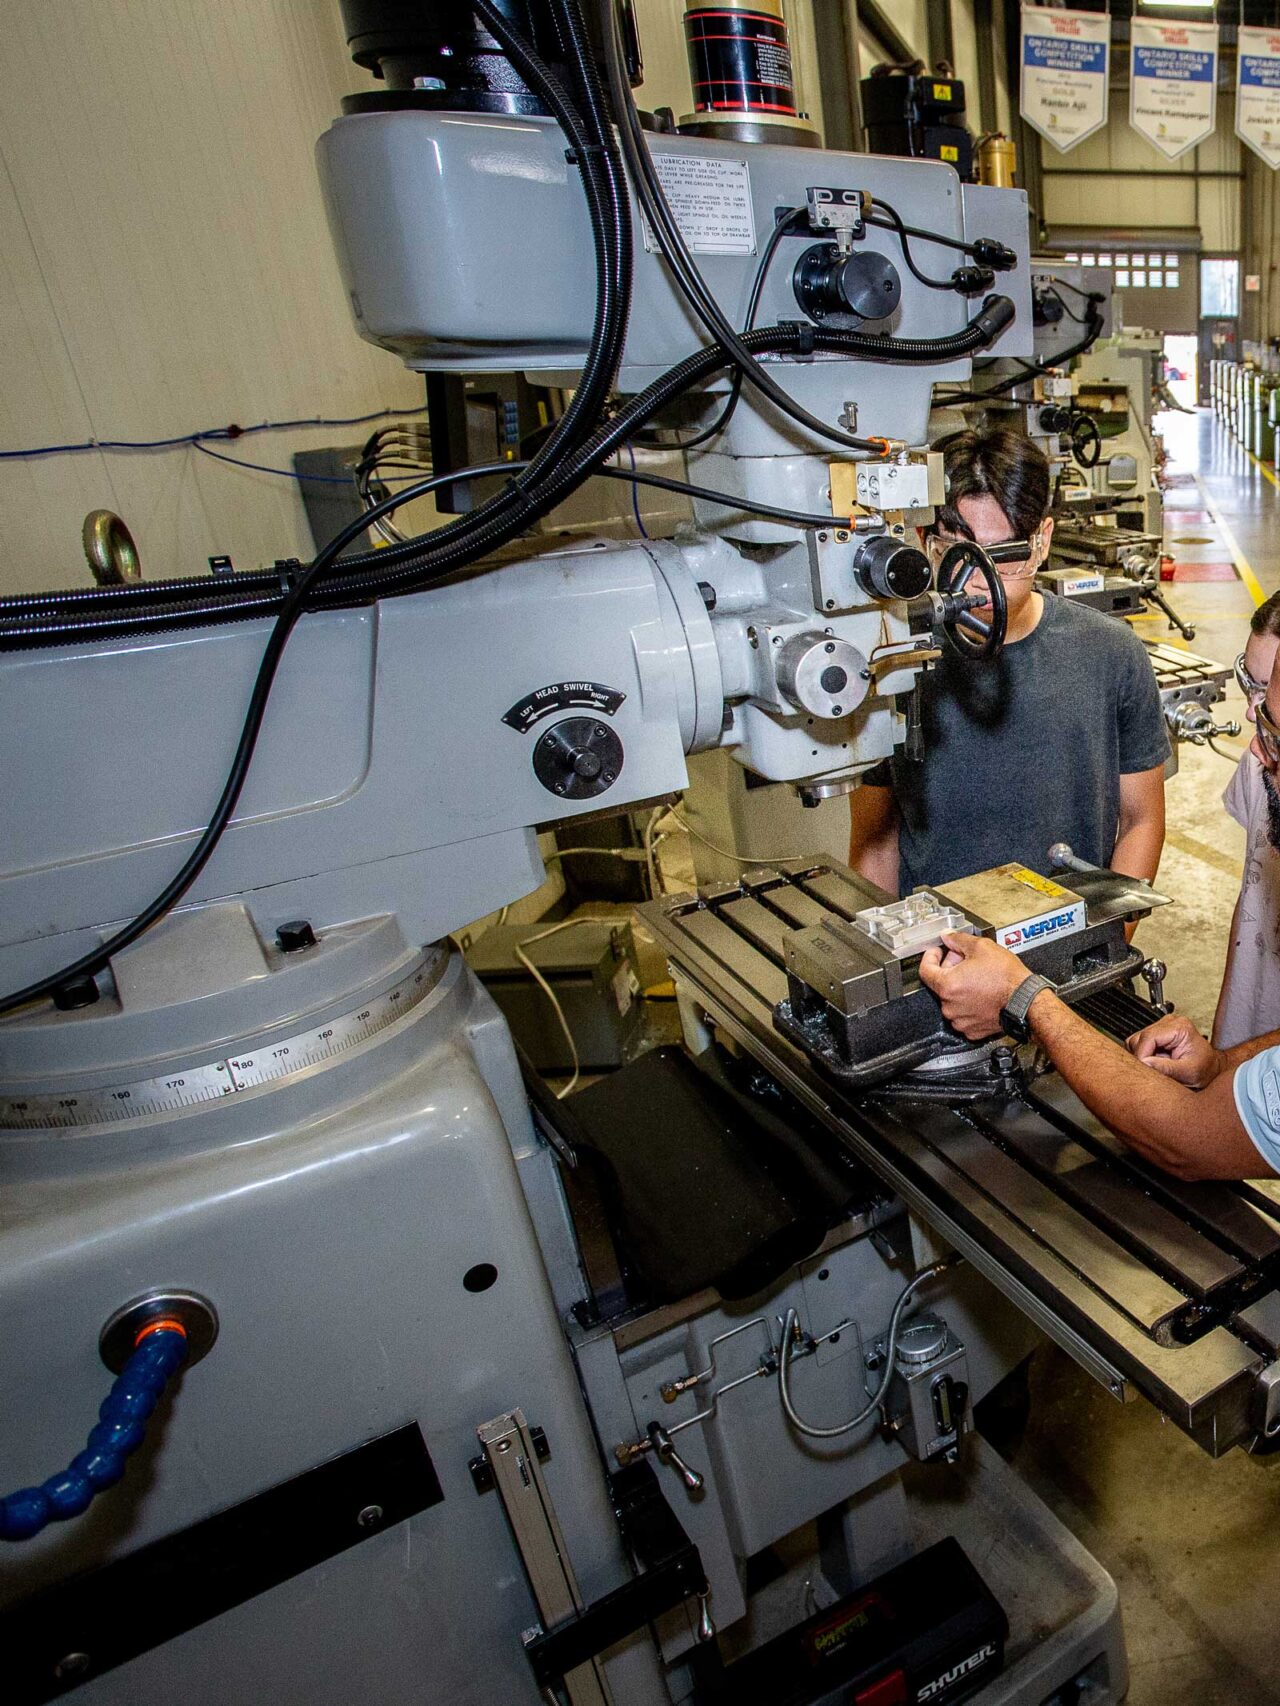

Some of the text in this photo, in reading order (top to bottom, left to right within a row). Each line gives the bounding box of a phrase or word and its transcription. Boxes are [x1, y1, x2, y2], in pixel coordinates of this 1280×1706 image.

[1028, 38, 1101, 54] ONTARIO SKILLS
[1034, 48, 1095, 62] COMPETITION
[1138, 49, 1209, 64] ONTARIO SKILLS
[1046, 59, 1082, 69] WINNER
[1143, 58, 1203, 72] COMPETITION
[1155, 68, 1190, 78] WINNER
[536, 684, 594, 700] HEAD SWIVEL
[590, 692, 610, 702] RIGHT
[520, 704, 534, 718] LEFT
[1021, 910, 1075, 939] VERTEX
[389, 992, 401, 1002] 140
[356, 1010, 370, 1022] 150
[318, 1029, 334, 1040] 160
[272, 1047, 290, 1058] 170
[236, 1060, 254, 1070] 180
[166, 1079, 186, 1090] 170
[112, 1090, 131, 1101] 160
[59, 1098, 78, 1108] 150
[917, 1644, 996, 1700] SHUTER
